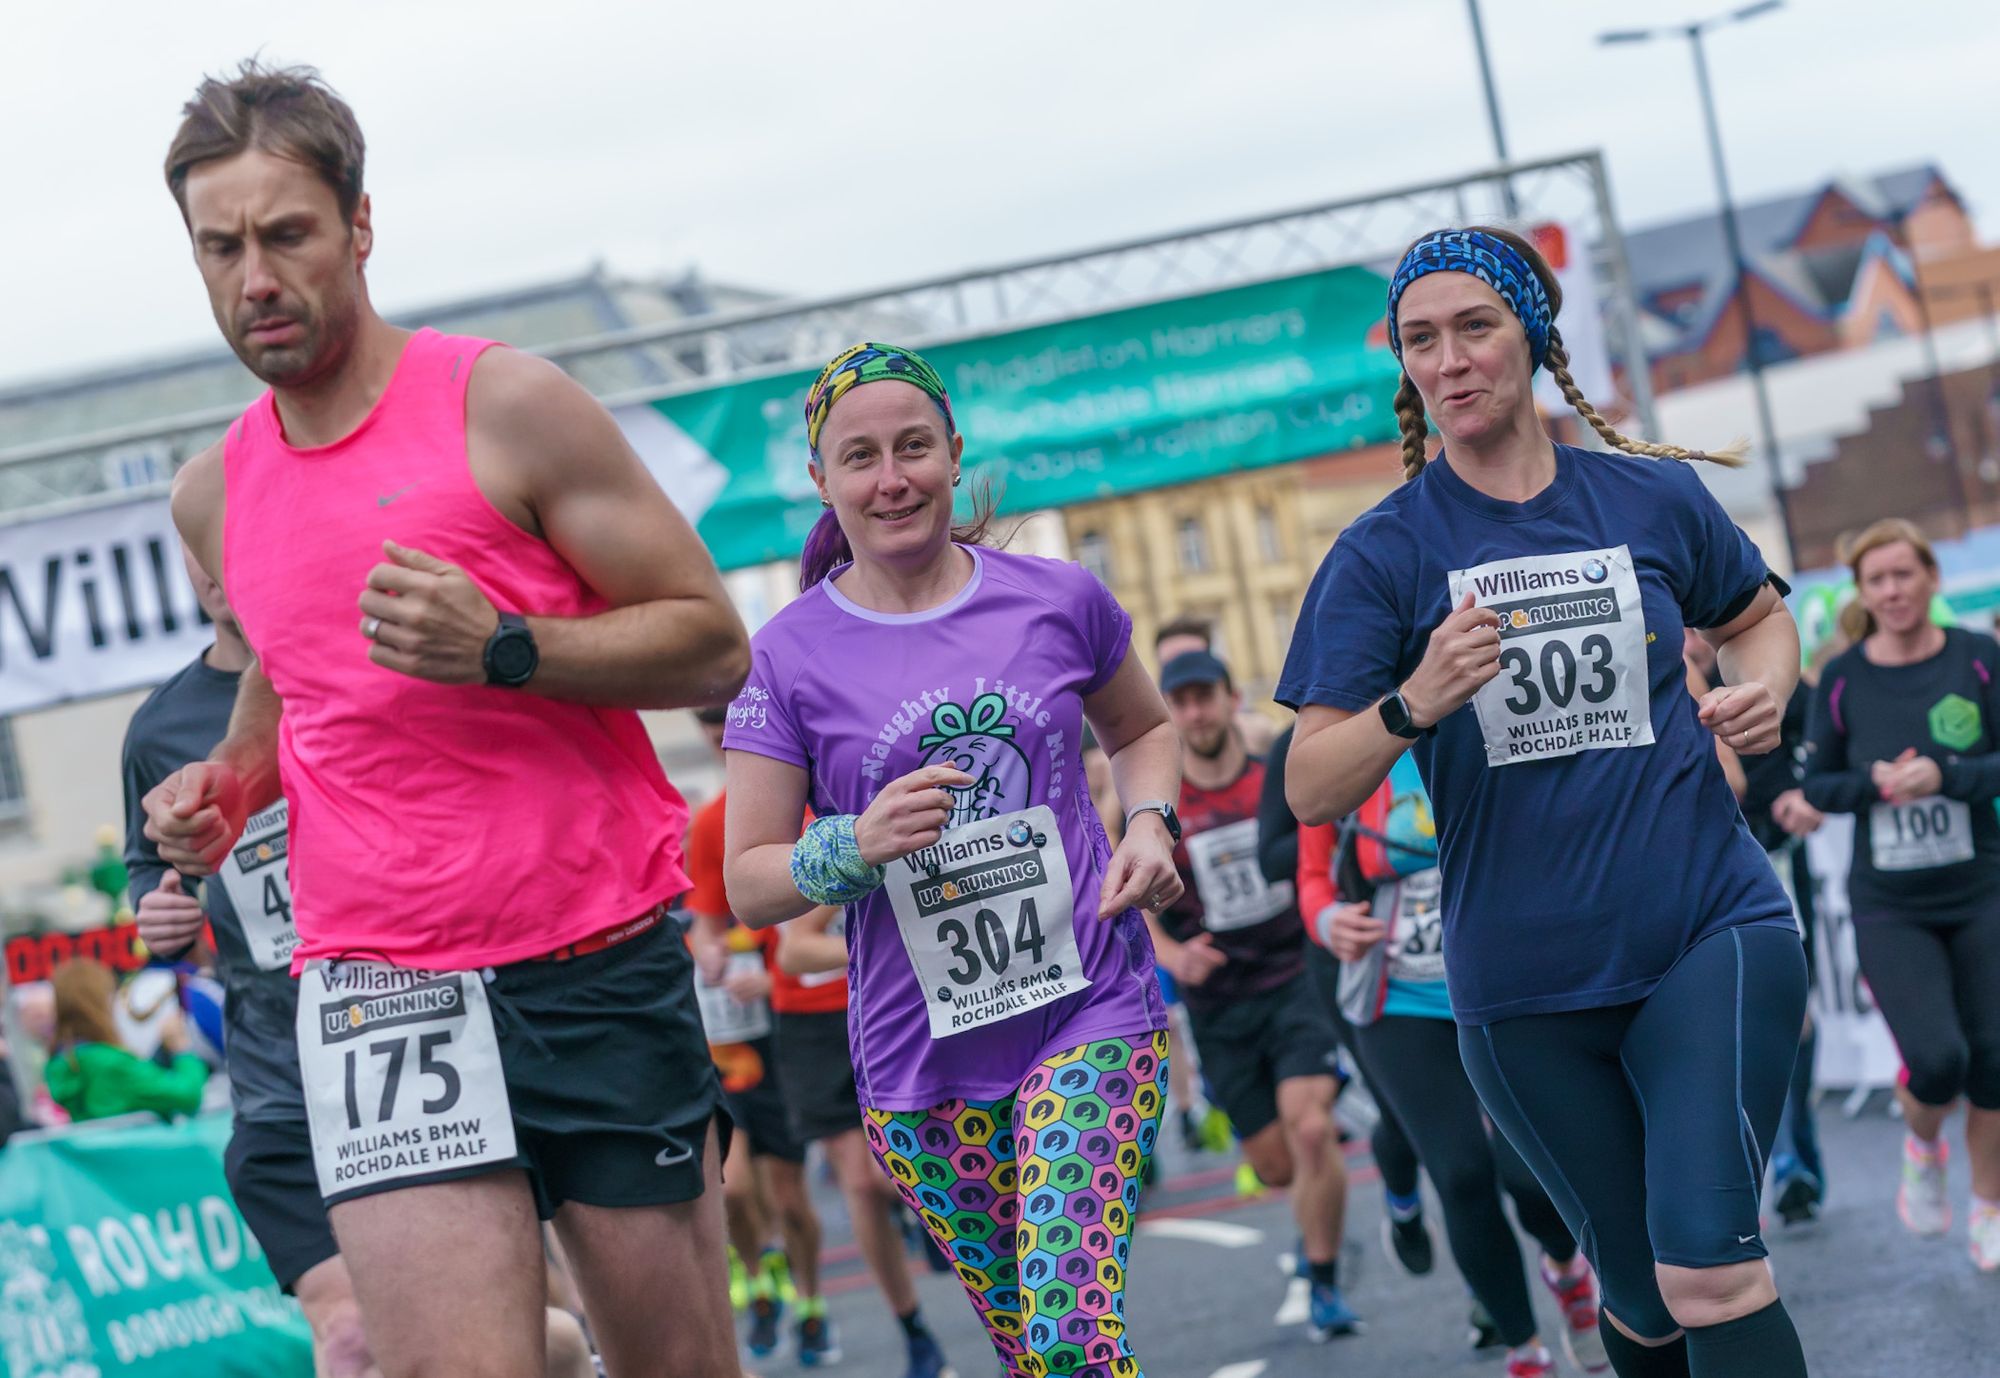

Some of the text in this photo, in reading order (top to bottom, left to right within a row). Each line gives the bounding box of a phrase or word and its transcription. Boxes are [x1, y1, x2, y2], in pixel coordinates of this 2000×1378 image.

[1474, 567, 1580, 598] Williams
[1497, 597, 1615, 629] P&RUNNING
[1500, 634, 1617, 716] 303
[1584, 709, 1629, 726] BMW
[1588, 727, 1632, 743] HALF
[861, 685, 949, 782] Naughty
[1045, 729, 1066, 800] Miss
[1892, 803, 1950, 842] 100
[903, 832, 1005, 874] Williams
[263, 866, 290, 924] 4
[918, 860, 1040, 908] UP&RUNNING
[936, 897, 1046, 986] 304
[952, 994, 1028, 1028] ROCHDALE
[1029, 982, 1068, 1002] HALF
[344, 1030, 462, 1131] 175
[335, 1138, 489, 1183] ROCHDALE HALF
[336, 1118, 482, 1161] WILLIAMS BMW
[66, 1194, 262, 1299] ROCHD
